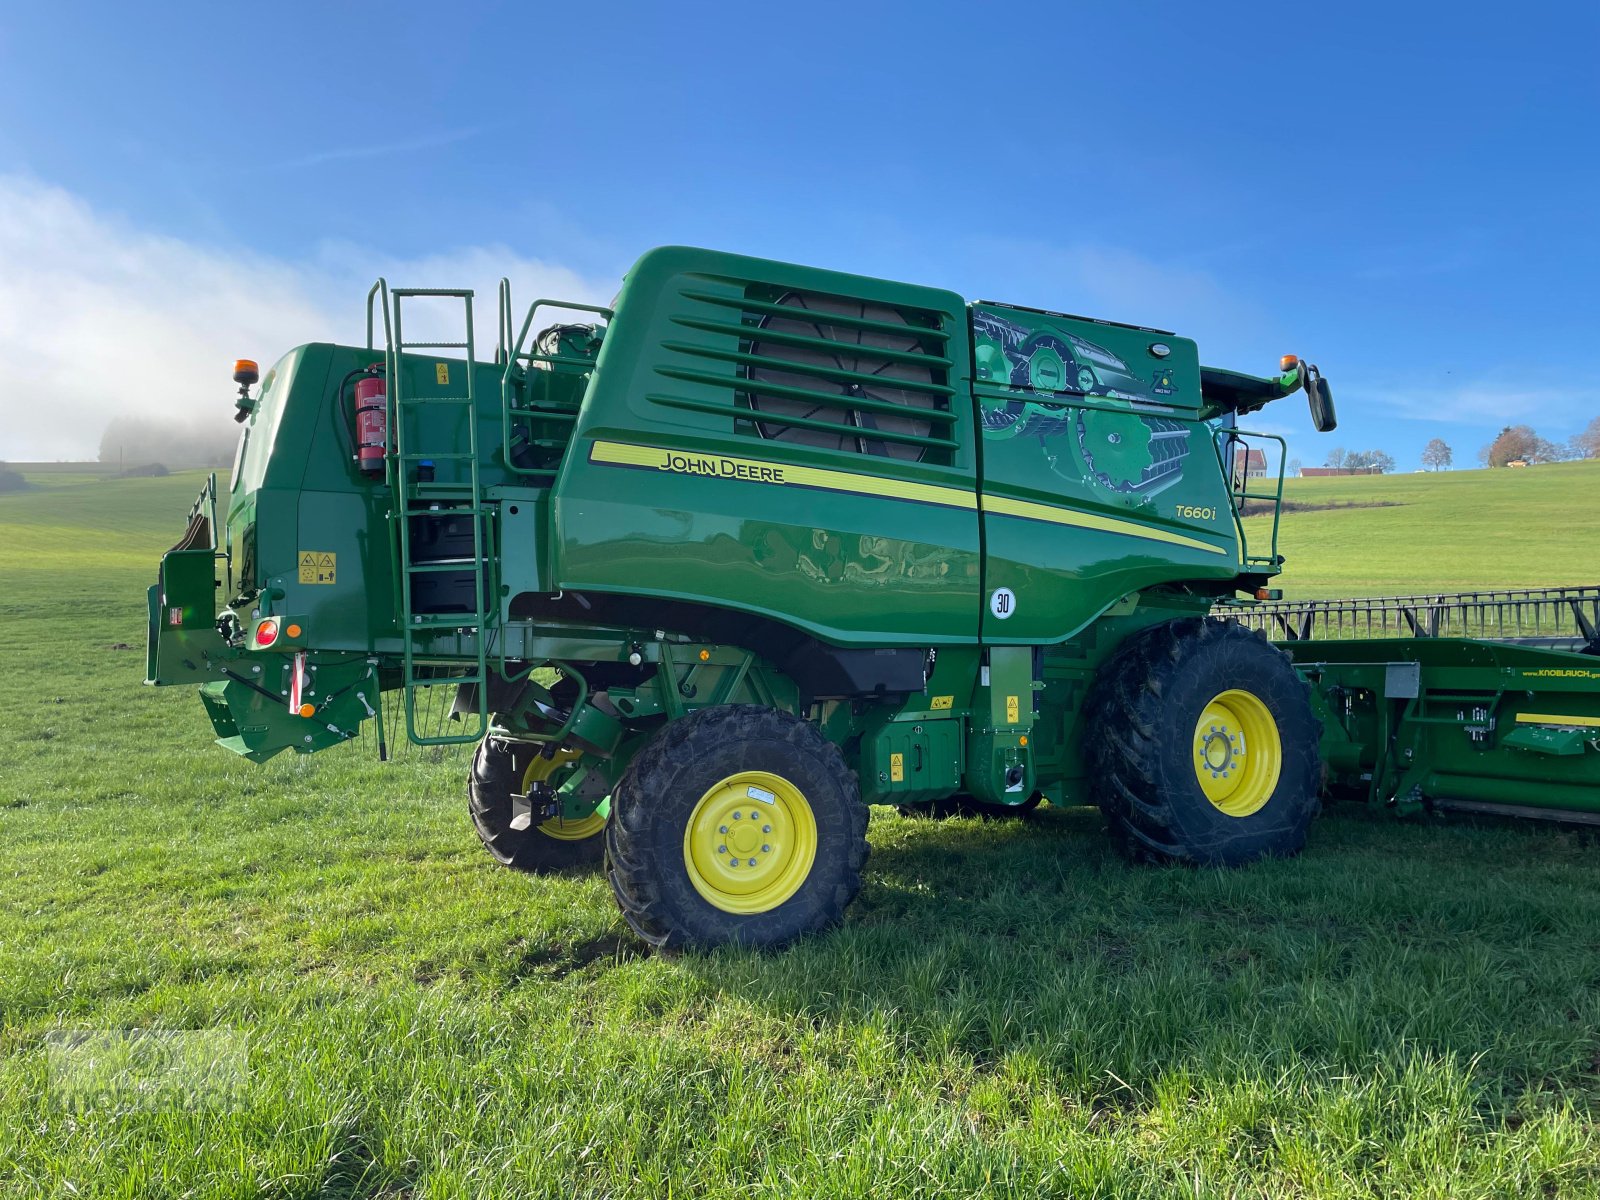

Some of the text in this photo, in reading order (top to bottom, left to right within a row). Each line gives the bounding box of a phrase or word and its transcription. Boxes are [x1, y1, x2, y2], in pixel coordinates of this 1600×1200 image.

[660, 452, 785, 482] JOHN DEERE
[1176, 504, 1216, 521] T660i
[996, 593, 1010, 614] 30
